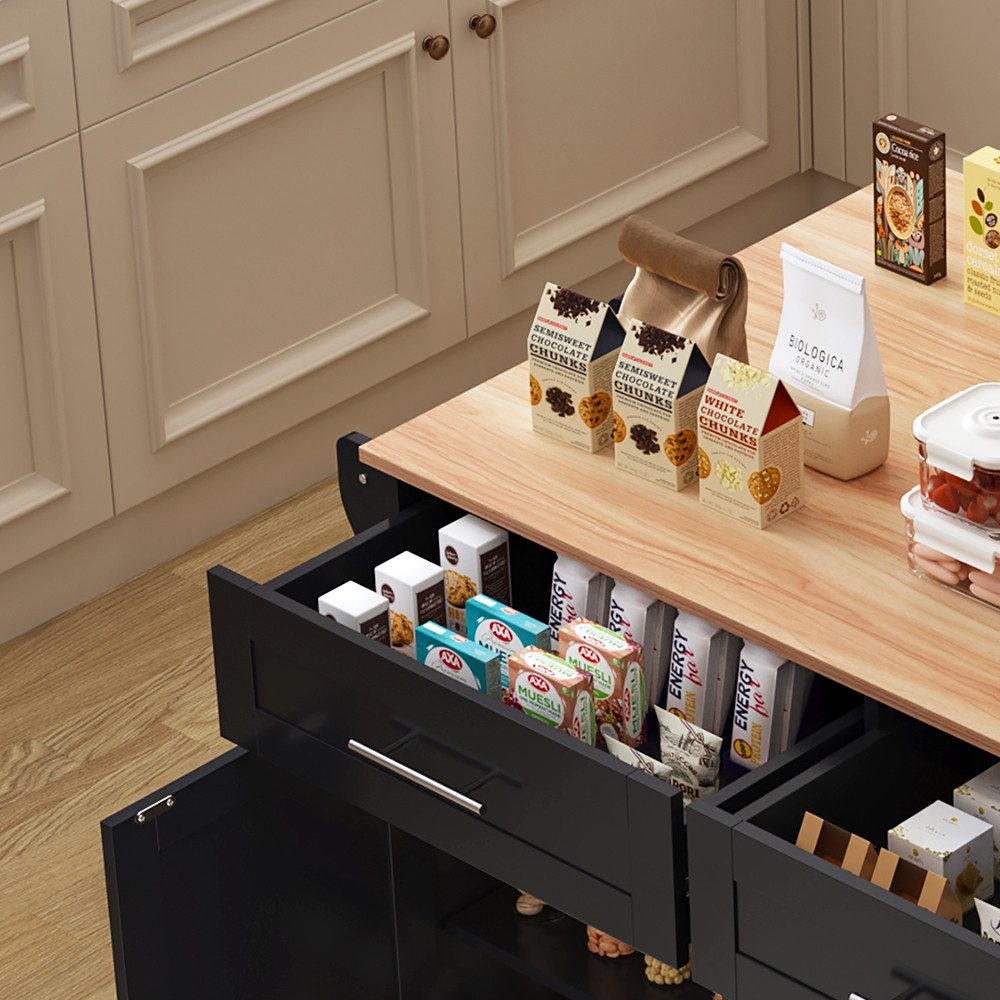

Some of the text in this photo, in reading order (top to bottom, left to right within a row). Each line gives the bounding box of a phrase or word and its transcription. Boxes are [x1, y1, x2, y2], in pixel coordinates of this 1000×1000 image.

[530, 333, 589, 361] CHOCOLATE
[533, 324, 592, 352] SEMISWEET
[530, 343, 587, 372] CHUNKS
[789, 334, 844, 372] BIOLOGICA
[795, 355, 830, 378] ORGANIC
[615, 370, 675, 399] CHOCOLATE
[618, 361, 678, 389] SEMISWEET
[614, 380, 673, 409] CHUNKS
[704, 395, 745, 419] WHITE
[699, 415, 757, 447] CHUNKS
[700, 405, 760, 436] CHOCOLATE
[550, 572, 567, 642] ENERGY
[492, 622, 511, 640] AXA
[441, 652, 461, 669] AXA
[581, 647, 599, 663] AXA
[669, 628, 688, 700] ENERGY
[529, 675, 549, 692] AXA
[735, 659, 754, 732] ENERGY
[518, 685, 561, 714] MUESLI
